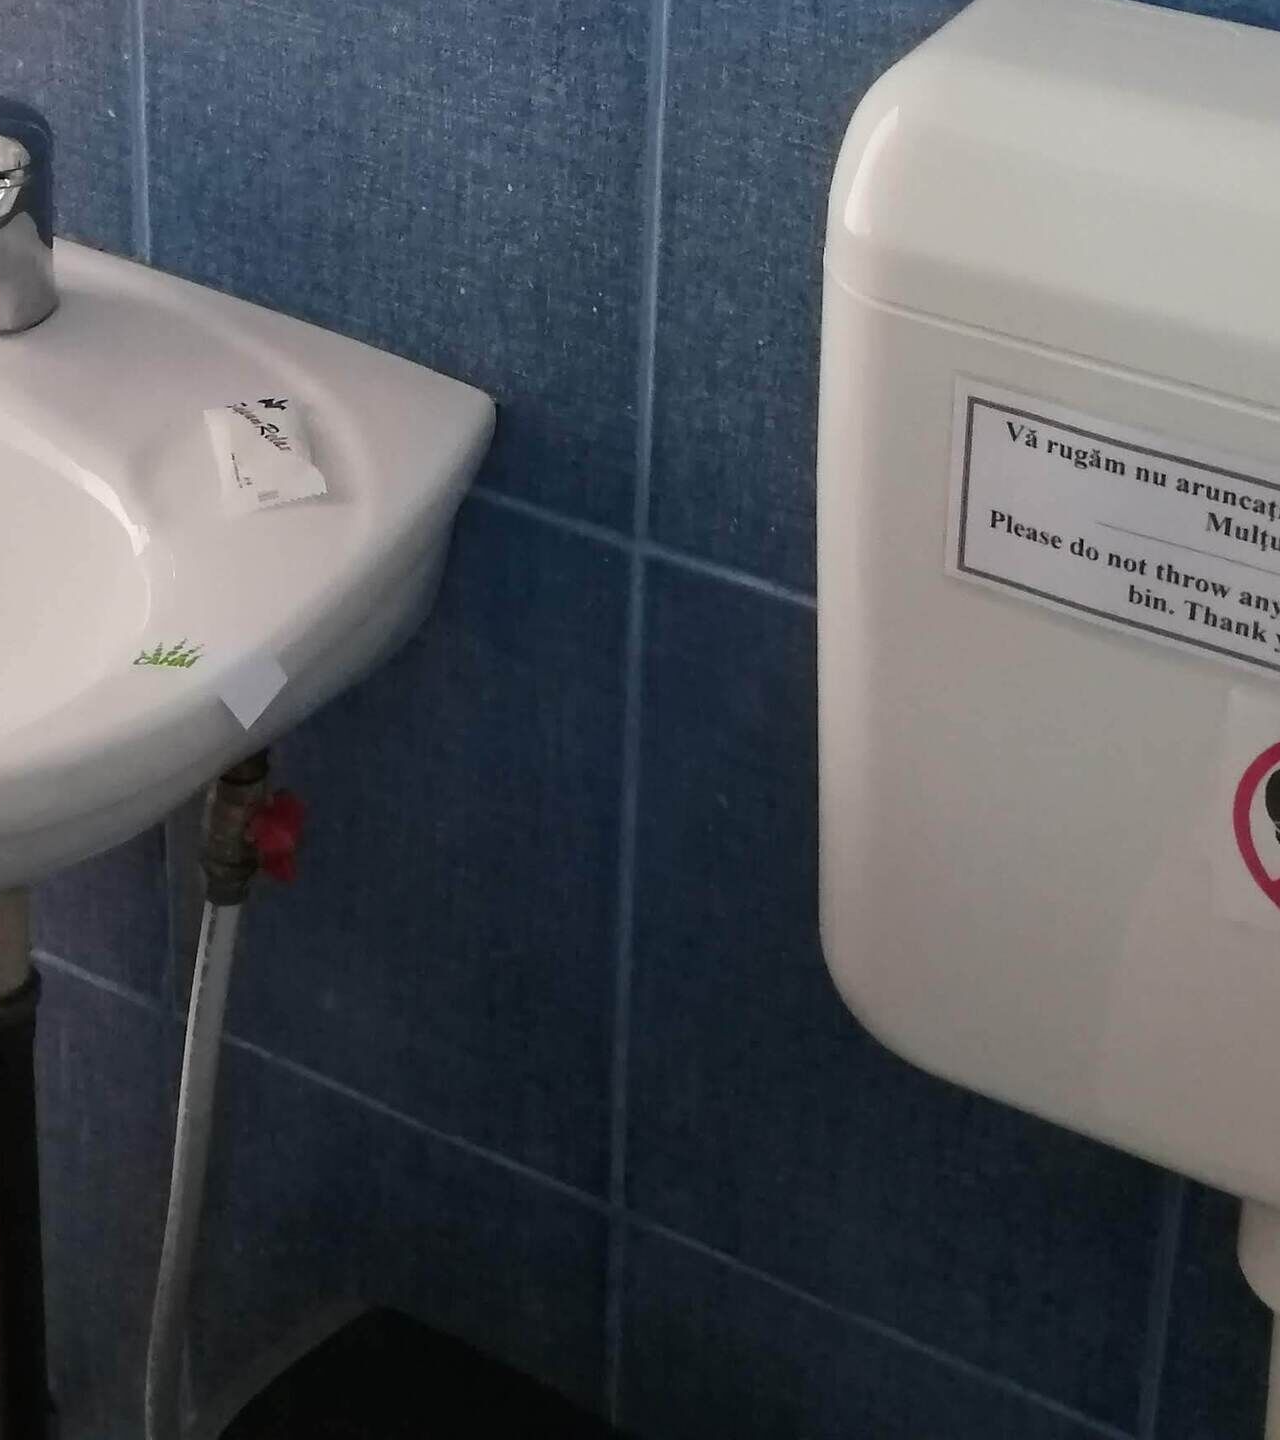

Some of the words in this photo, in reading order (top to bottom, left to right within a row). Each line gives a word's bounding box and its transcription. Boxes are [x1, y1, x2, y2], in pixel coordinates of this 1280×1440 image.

[1006, 421, 1038, 448] Vă
[1047, 439, 1125, 476] rugăm
[1135, 463, 1167, 487] nu
[989, 509, 1063, 550] Please
[1069, 537, 1100, 562] do
[1107, 551, 1148, 577] not
[1155, 562, 1232, 600] throw
[1127, 583, 1176, 615] bin.
[1183, 599, 1268, 644] Thank
